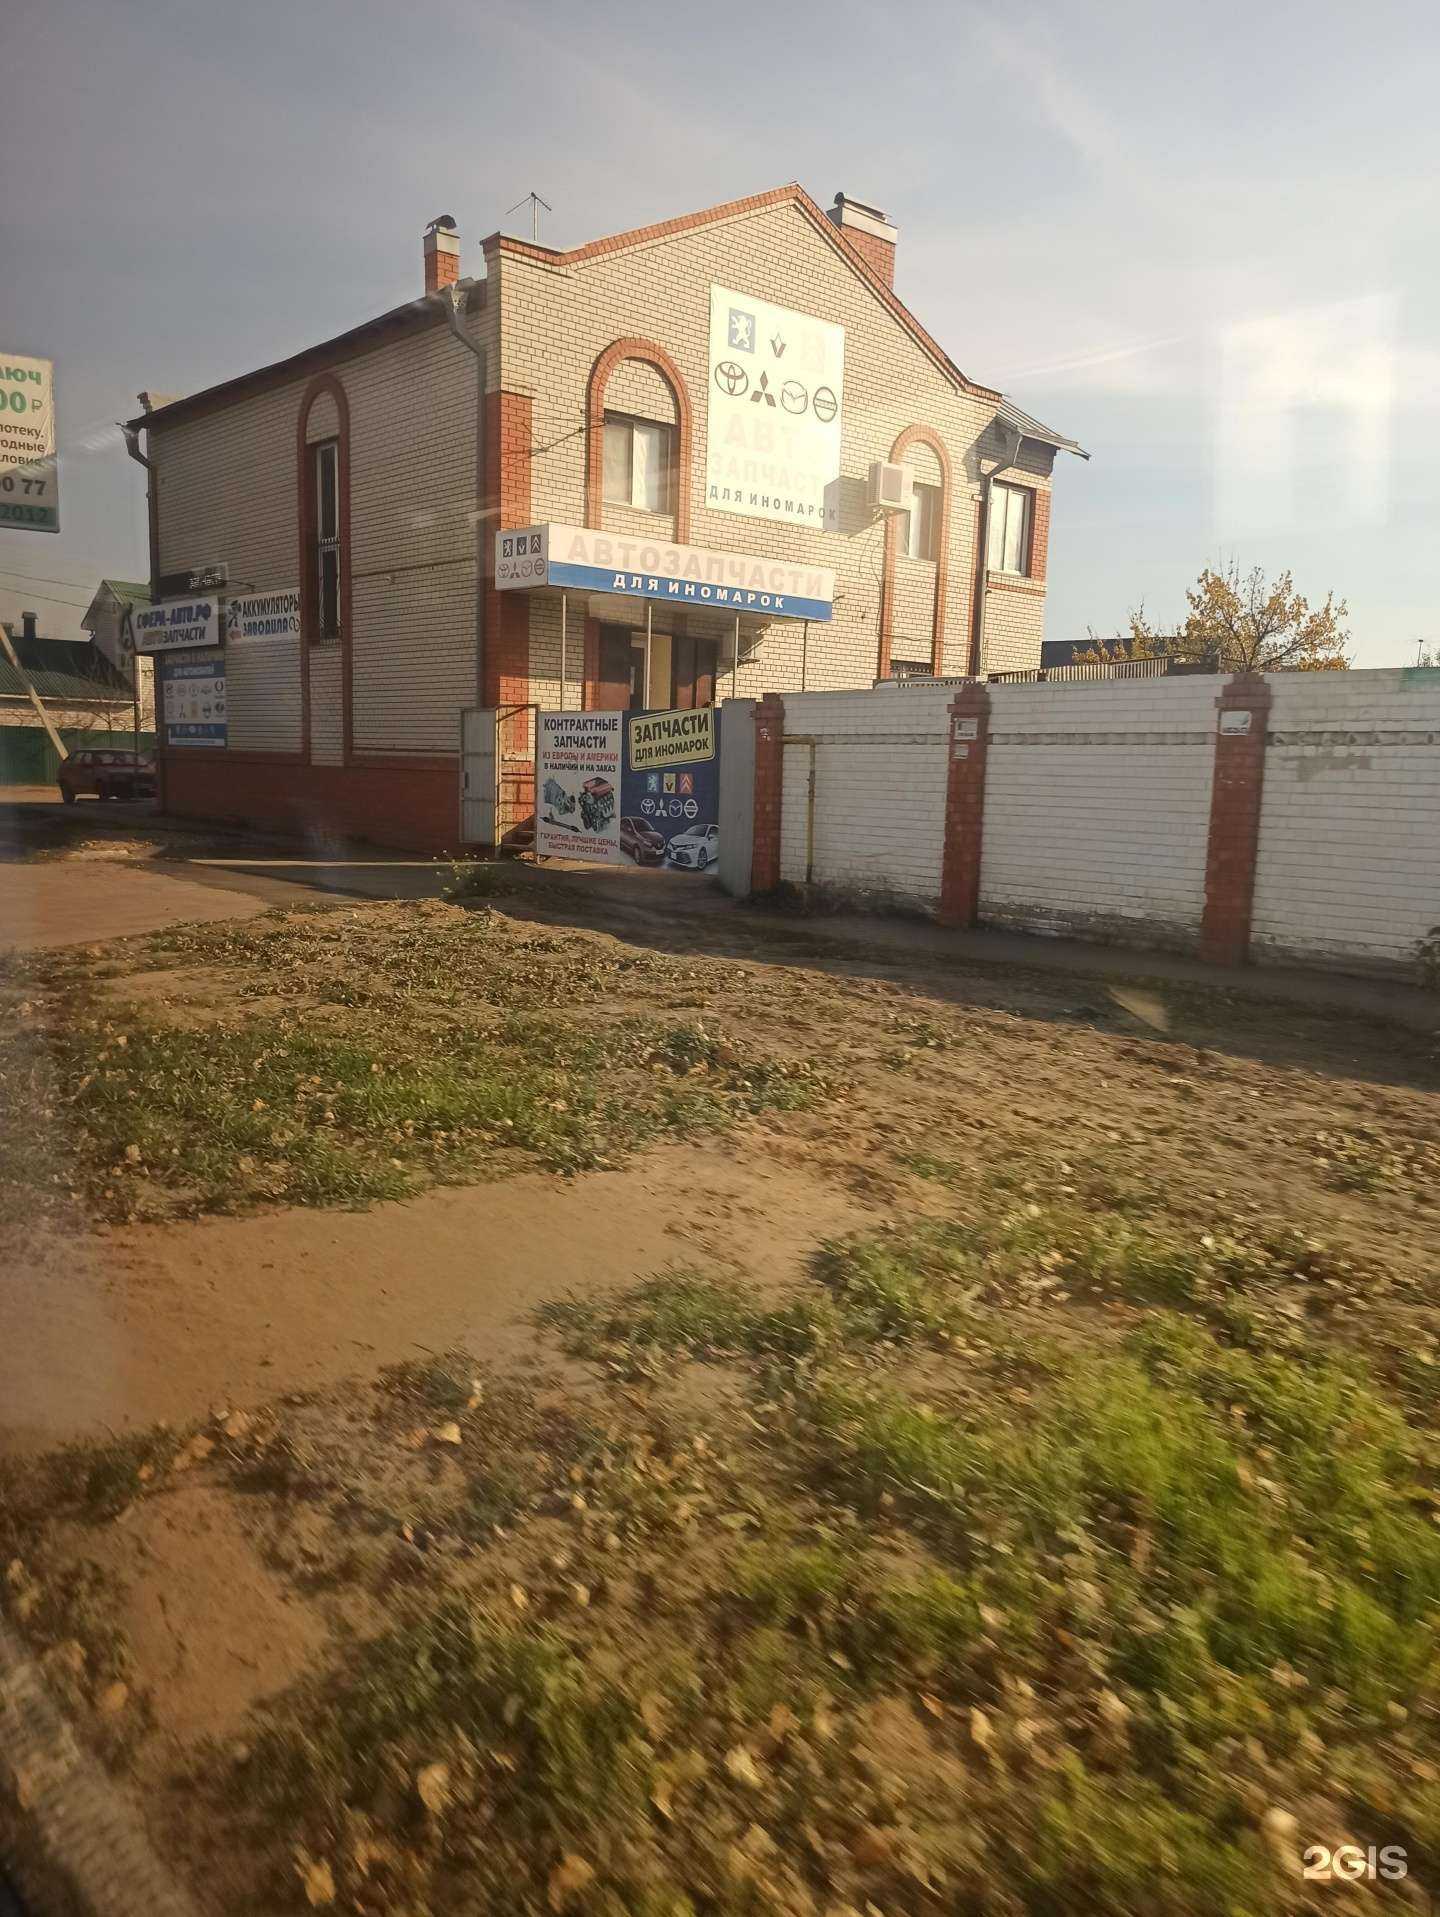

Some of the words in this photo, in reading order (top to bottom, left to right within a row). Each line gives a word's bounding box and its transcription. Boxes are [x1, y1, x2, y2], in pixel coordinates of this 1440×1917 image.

[22, 478, 46, 496] 77
[709, 485, 742, 503] ДЛЯ
[750, 492, 836, 521] ИНОМАРОК
[568, 535, 824, 597] АВТОЗАПЧАСТИ
[613, 574, 658, 592] ДЛЯ
[669, 581, 785, 609] ИНОМАРОК
[242, 593, 300, 617] АККУМУЛЯТОРЫ
[544, 718, 618, 731] КОНТРАКТНЫЕ
[634, 713, 709, 744] ЗАПЧАСТИ
[554, 736, 606, 749] ЗАПЧАСТИ
[635, 748, 653, 762] ДЛЯ
[656, 738, 709, 760] ИНОМАРОК
[550, 763, 578, 771] НАЛИЧИИ
[552, 751, 579, 761] ЕВРОПЫ
[587, 752, 618, 762] АМЕРИКИ
